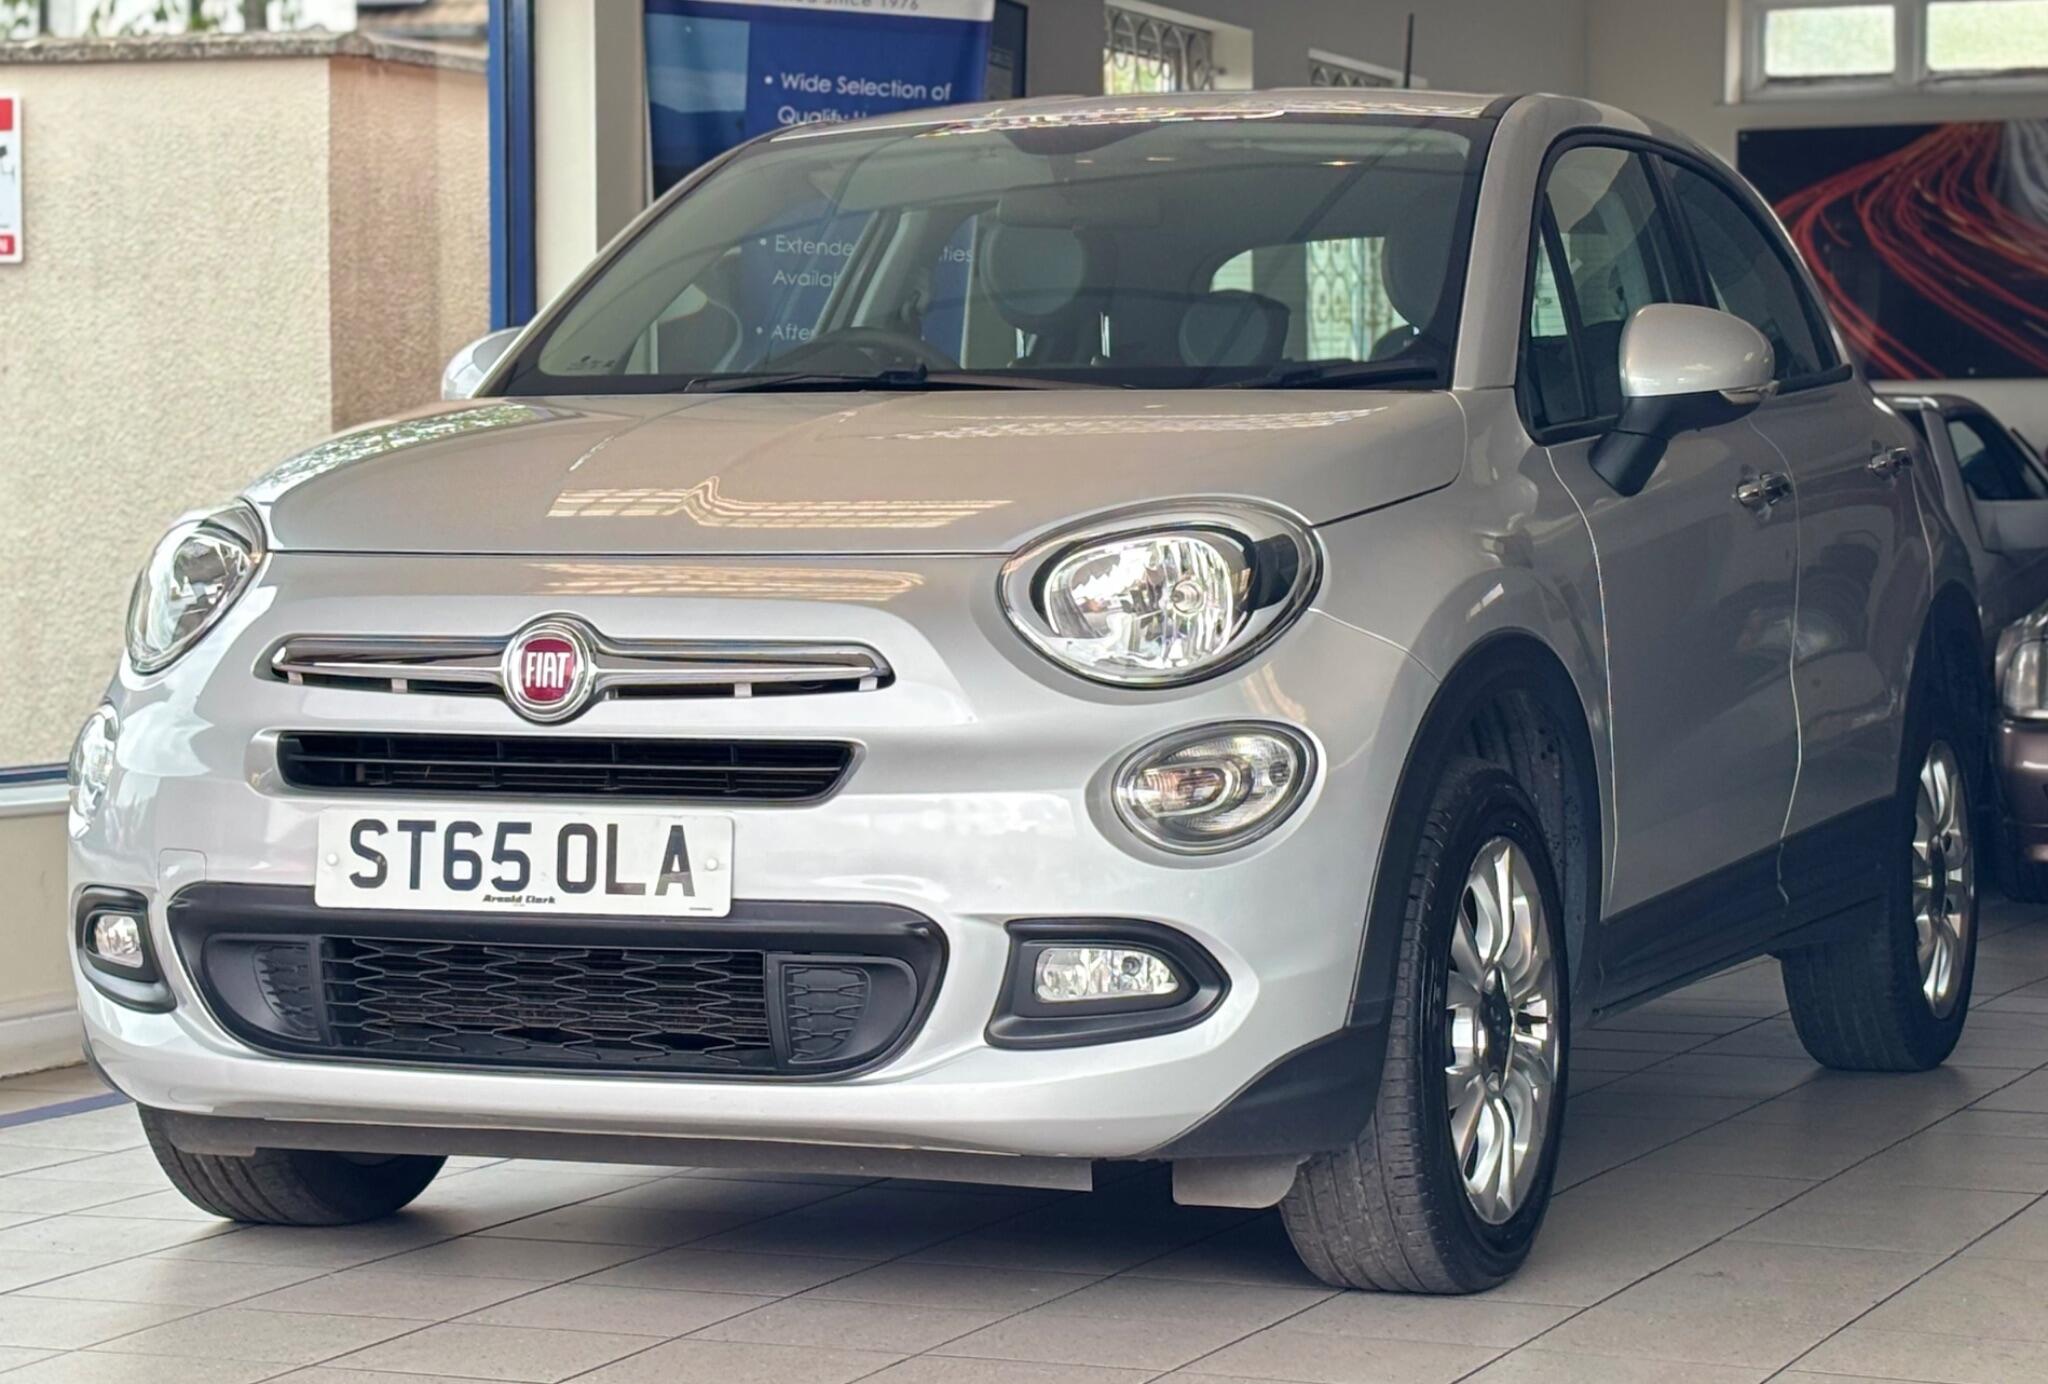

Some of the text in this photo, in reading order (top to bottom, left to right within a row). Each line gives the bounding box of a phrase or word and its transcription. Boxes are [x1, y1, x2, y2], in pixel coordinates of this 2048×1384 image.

[780, 73, 952, 101] Wide Selection of
[775, 234, 852, 257] Extende
[525, 651, 571, 689] FIAT
[349, 818, 696, 897] ST65 OLA
[482, 894, 556, 905] Arnold Clark
